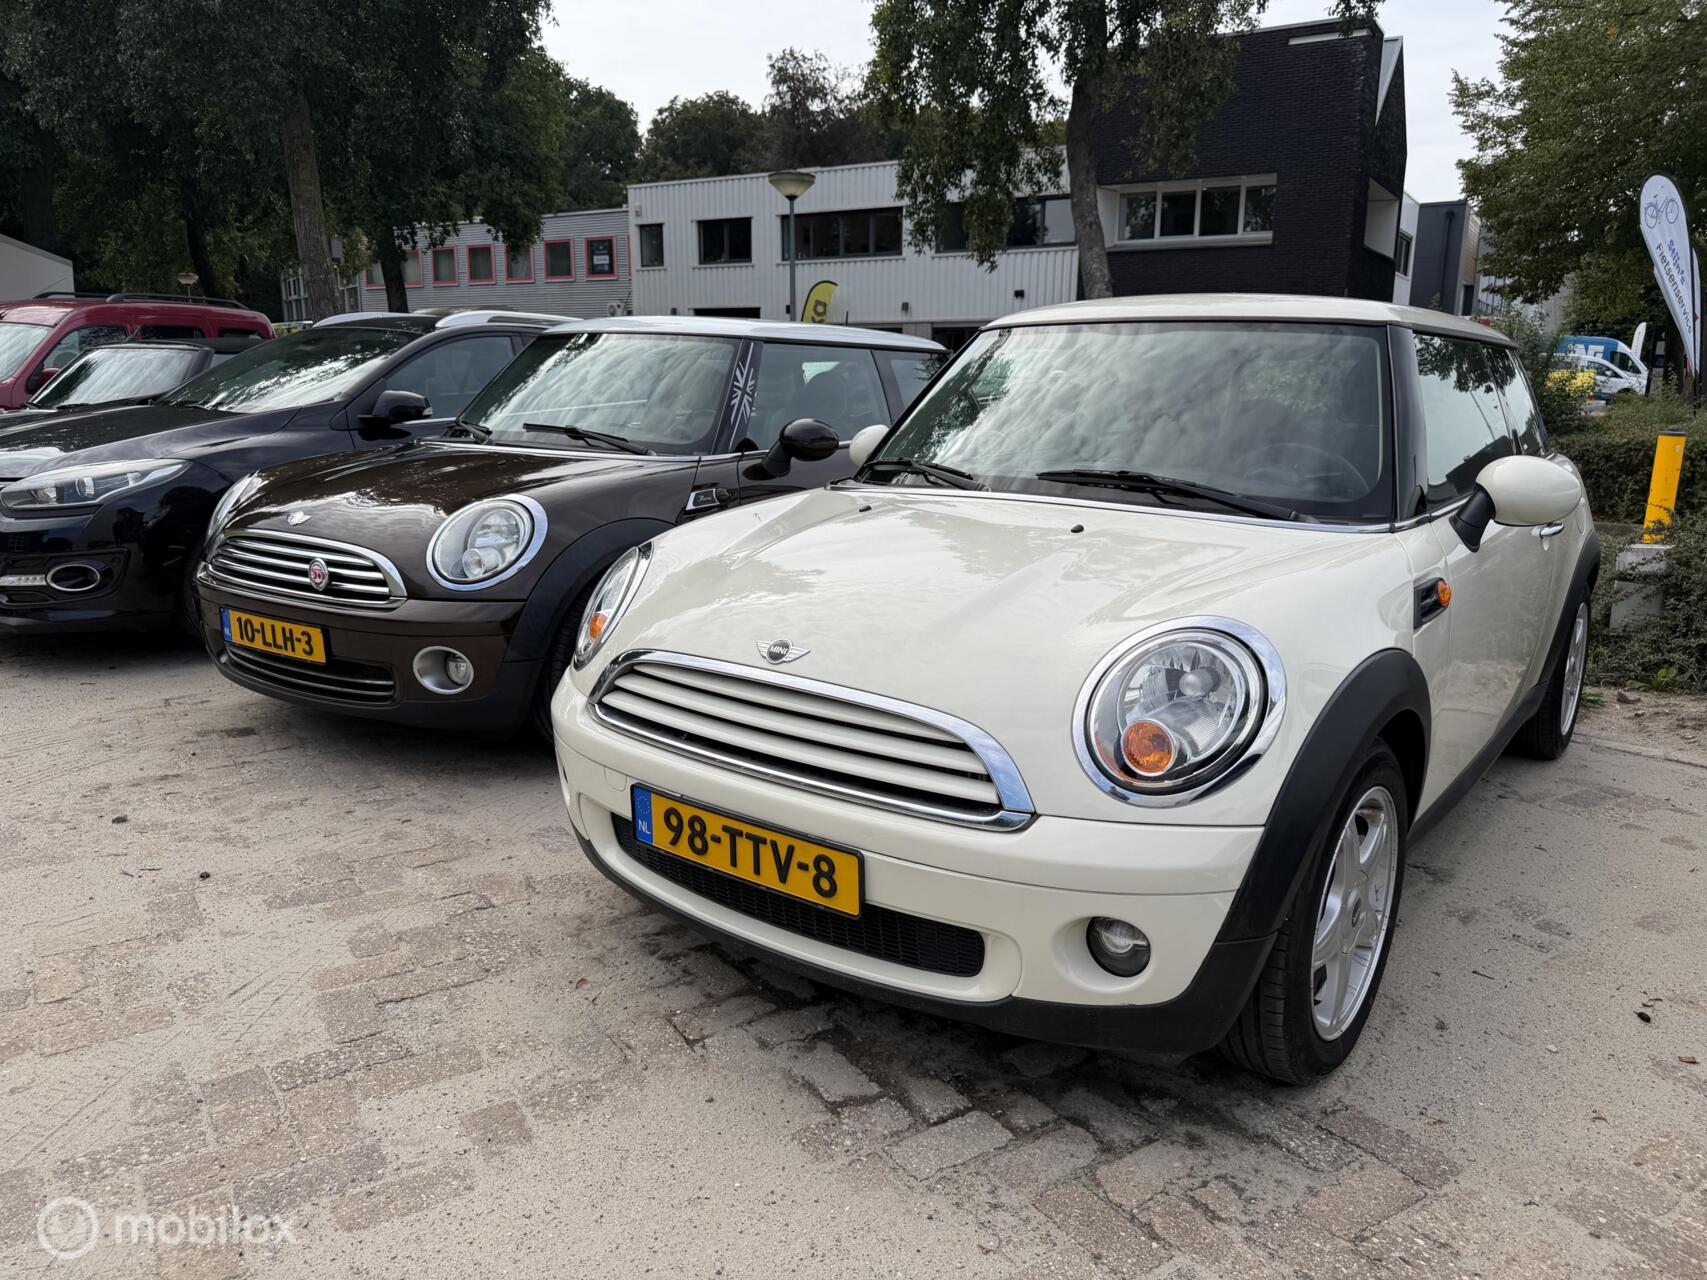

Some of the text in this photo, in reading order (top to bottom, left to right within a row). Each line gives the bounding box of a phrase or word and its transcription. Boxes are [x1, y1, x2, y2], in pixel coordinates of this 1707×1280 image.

[236, 616, 314, 656] 10-LLH-3
[769, 645, 788, 655] MINI
[638, 819, 651, 834] NL
[664, 806, 838, 898] 98-TTV-8
